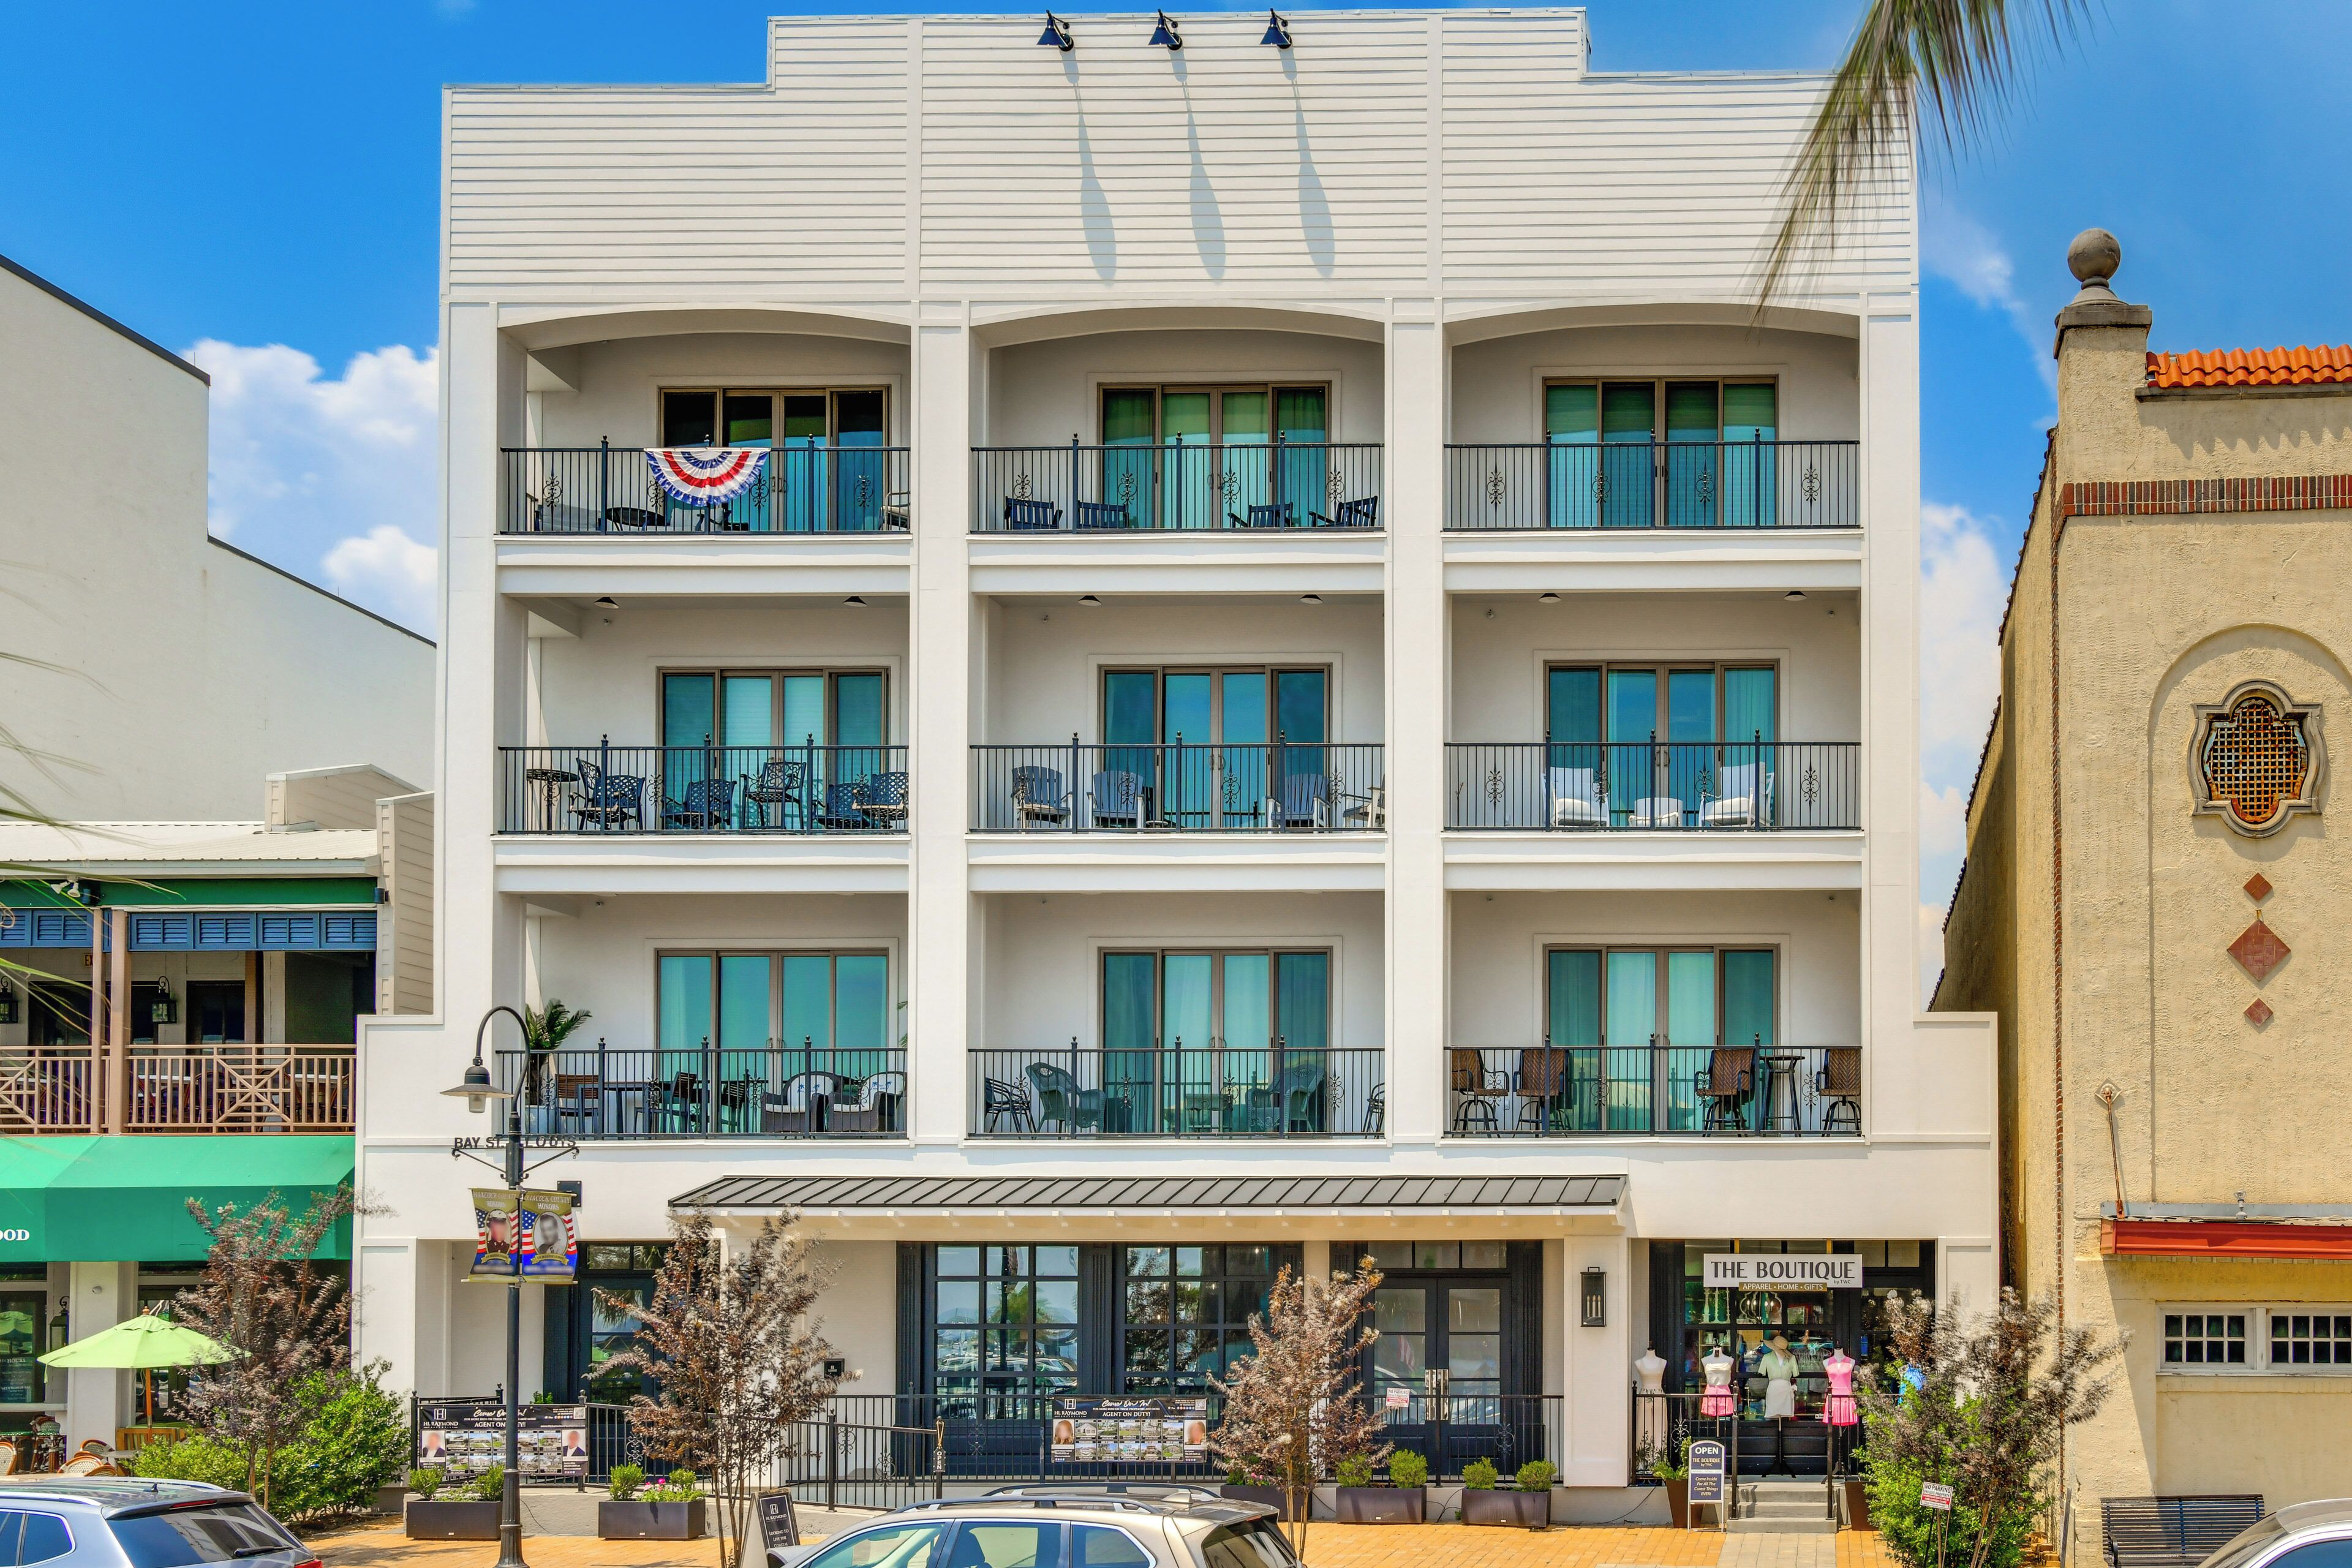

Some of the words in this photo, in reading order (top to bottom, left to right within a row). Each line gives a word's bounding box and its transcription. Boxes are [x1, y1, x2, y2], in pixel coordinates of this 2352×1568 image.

[454, 1137, 481, 1148] BAY
[486, 1136, 505, 1148] ST.
[526, 1135, 576, 1148] LOUIS
[1711, 1261, 1747, 1278] THE
[1756, 1261, 1855, 1280] BOUTIQUE
[473, 1409, 496, 1417] Come
